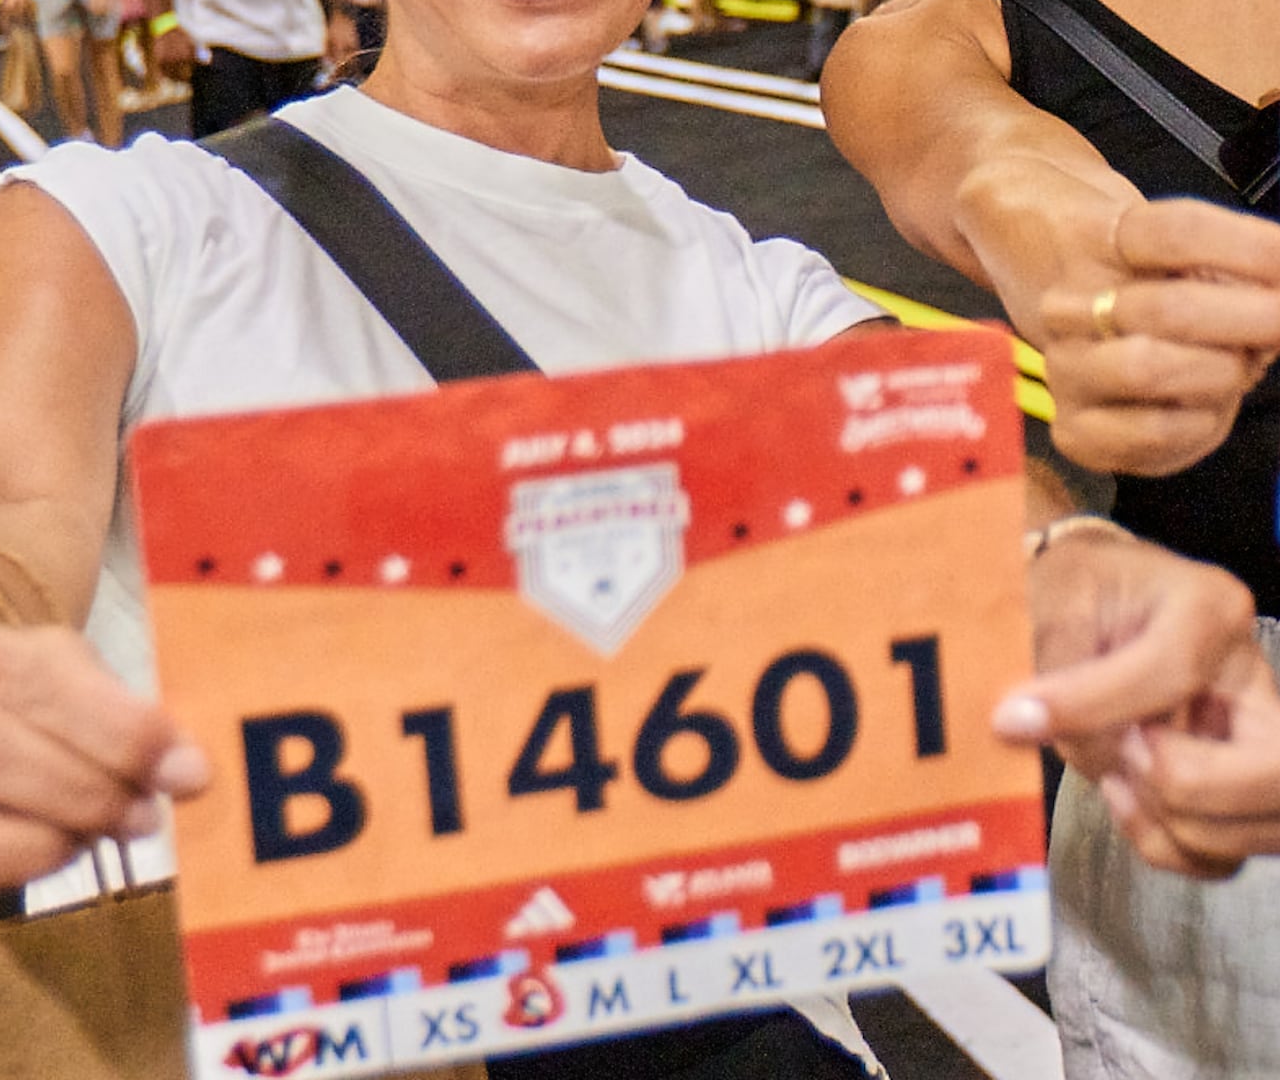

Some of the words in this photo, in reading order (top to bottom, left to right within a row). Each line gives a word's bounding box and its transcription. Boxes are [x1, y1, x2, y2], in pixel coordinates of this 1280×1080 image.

[241, 632, 948, 864] B14601
[314, 1023, 368, 1067] M
[421, 1001, 481, 1047] XS
[587, 977, 632, 1020] M
[669, 967, 688, 1004] L
[731, 953, 783, 992] XL
[823, 931, 906, 980] 2XL
[944, 916, 1023, 961] 3XL
